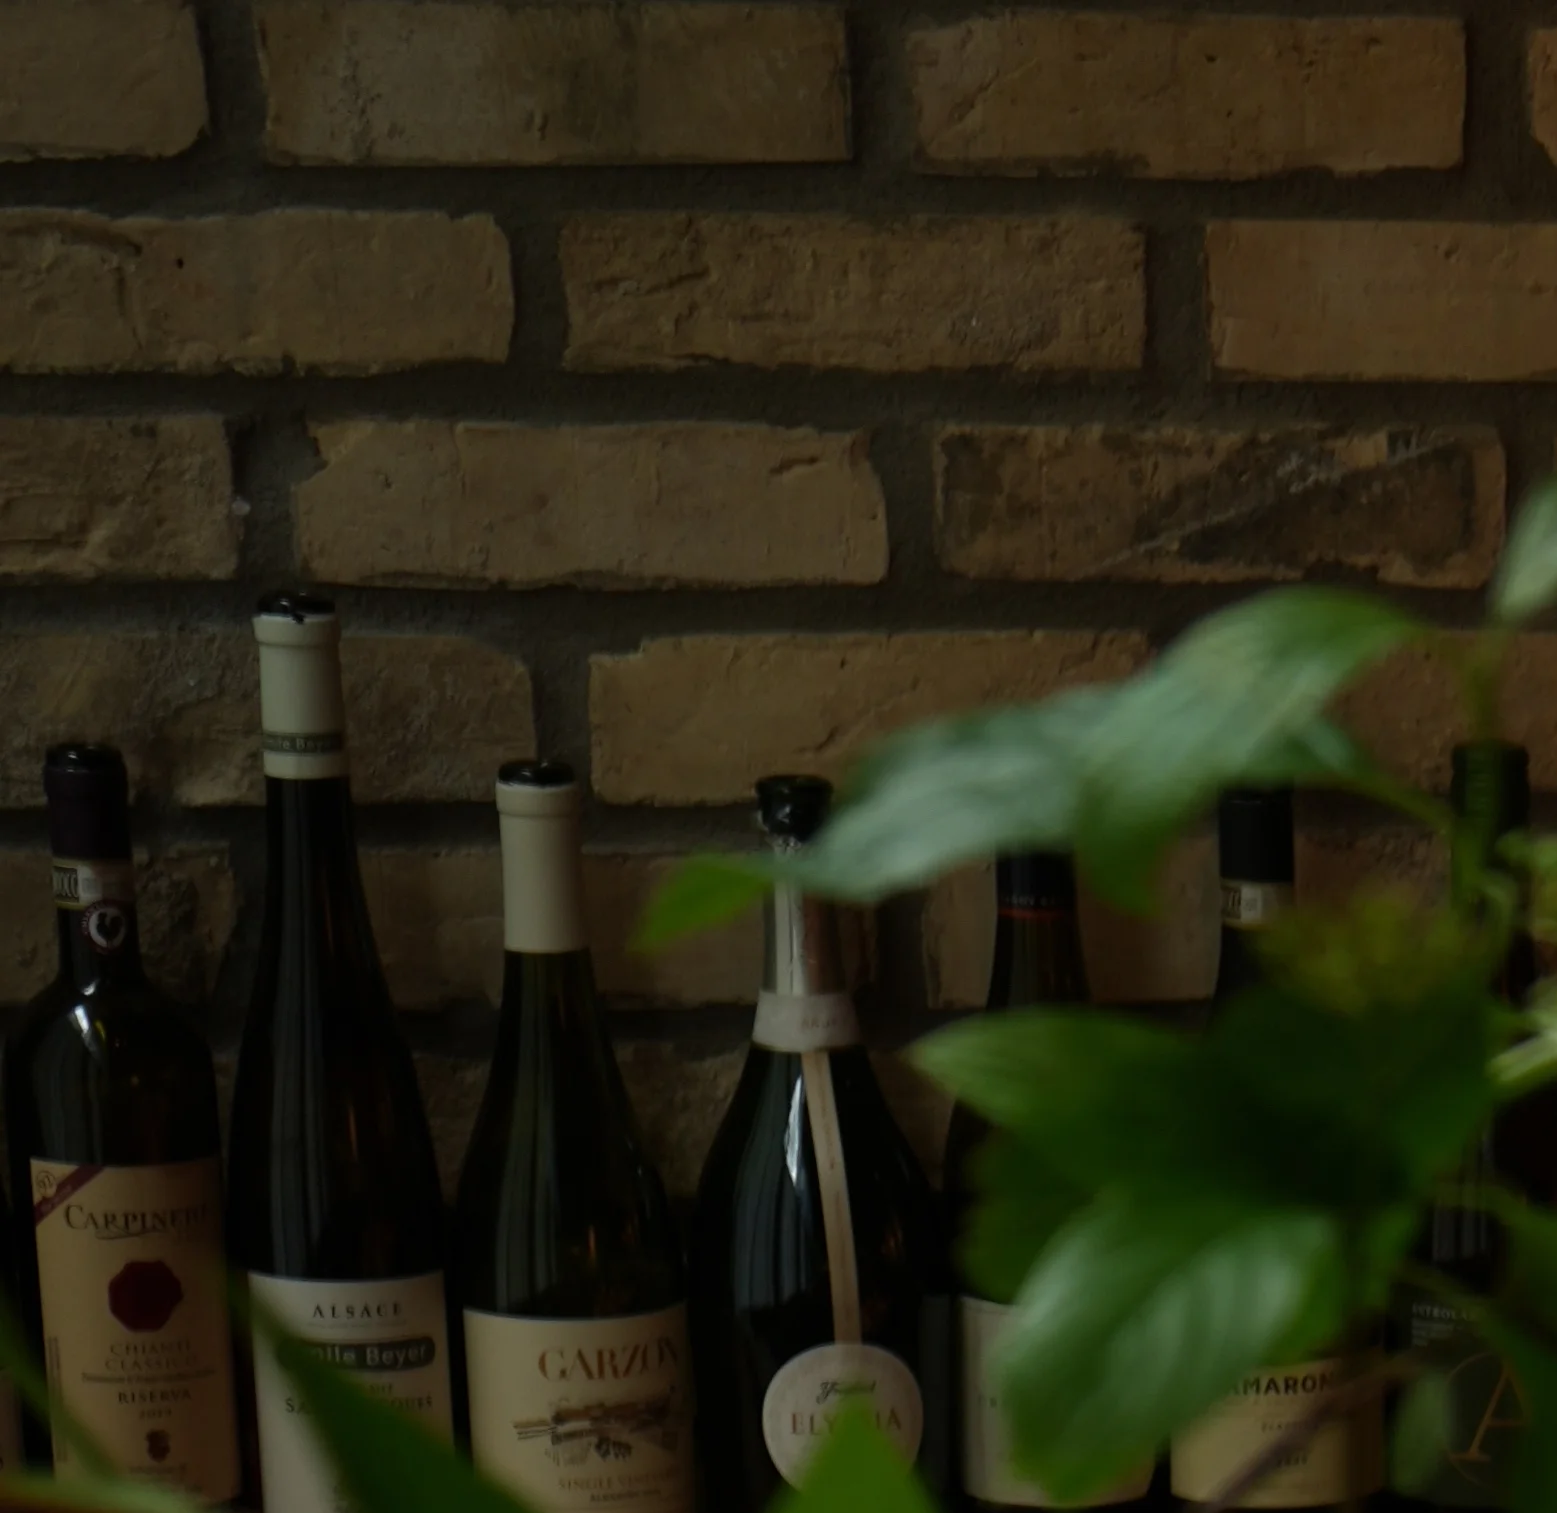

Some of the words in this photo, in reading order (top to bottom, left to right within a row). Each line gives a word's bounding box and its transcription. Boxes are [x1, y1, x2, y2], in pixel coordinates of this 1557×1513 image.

[64, 1202, 209, 1234] CARPINET
[311, 1302, 404, 1320] ALSACE
[365, 1341, 430, 1368] Beyer
[117, 1387, 192, 1405] RISERVA
[791, 1407, 901, 1435] ELYIA
